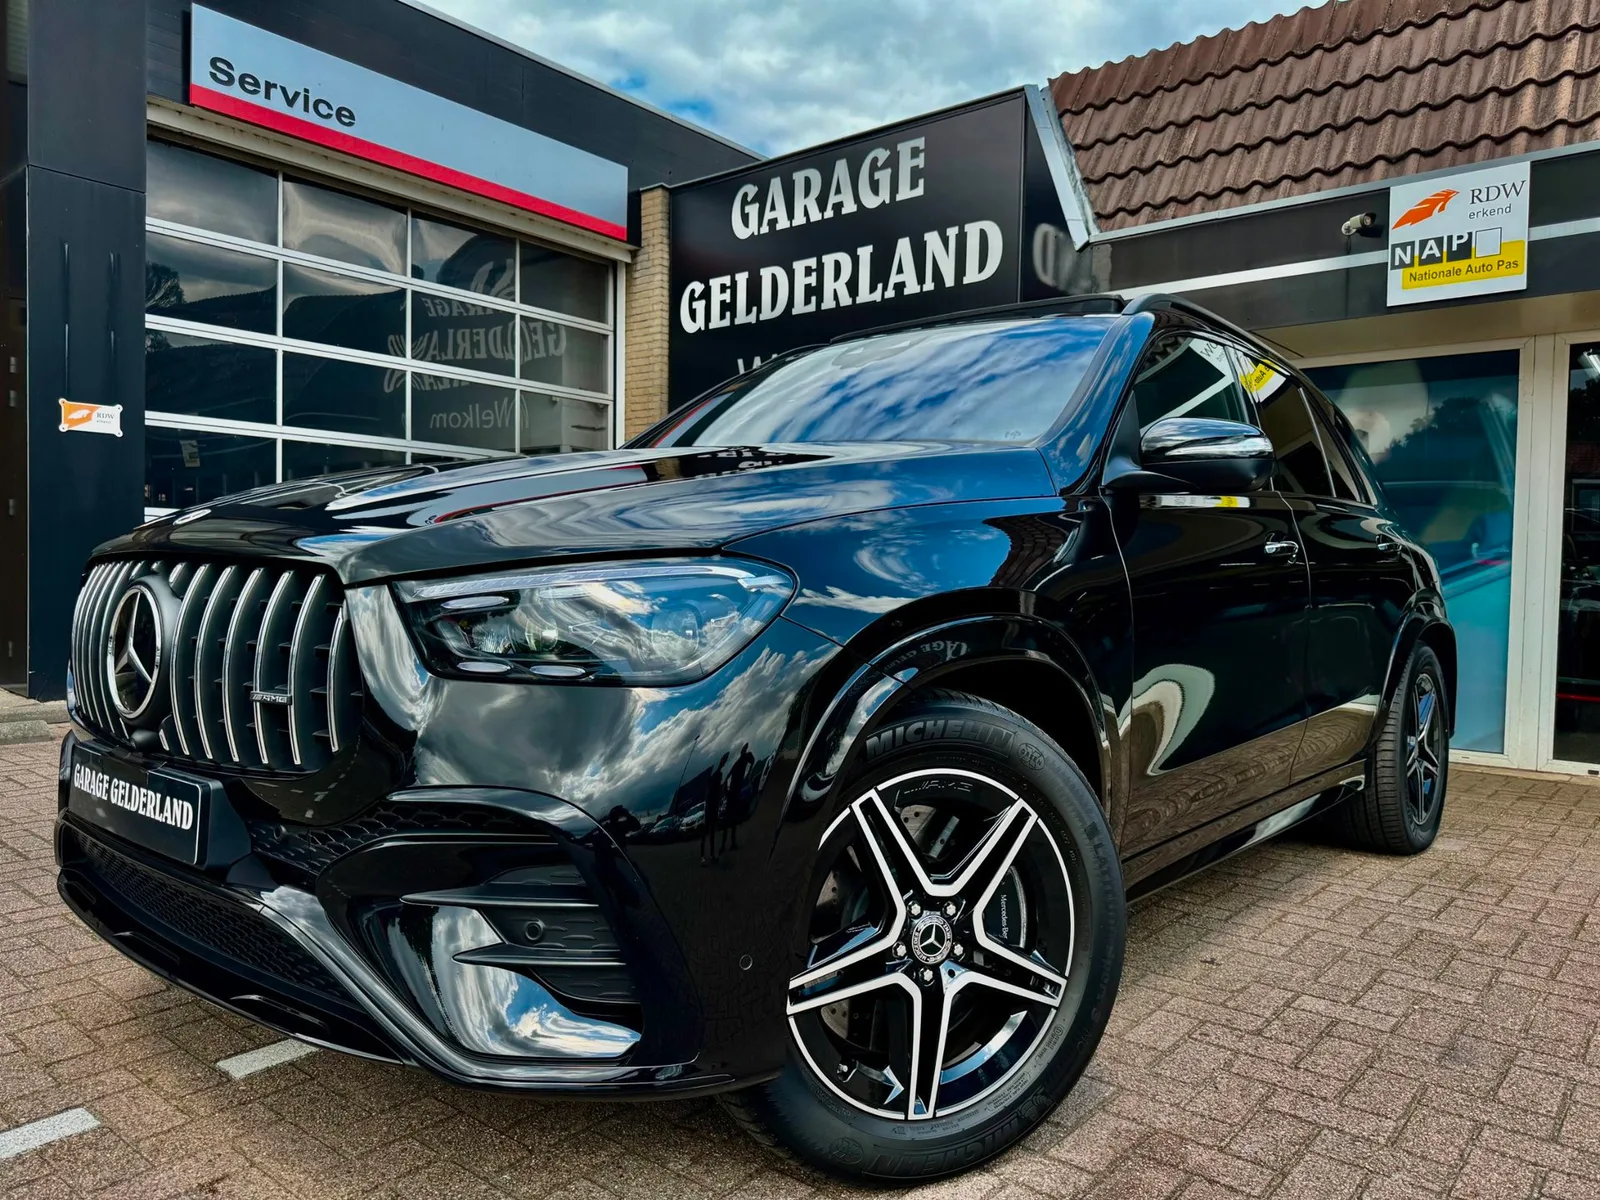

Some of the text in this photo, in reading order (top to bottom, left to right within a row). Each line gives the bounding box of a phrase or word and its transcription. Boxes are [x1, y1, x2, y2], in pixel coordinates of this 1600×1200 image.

[209, 56, 356, 128] Service
[731, 137, 926, 240] GARAGE
[1469, 180, 1527, 205] RDW
[1468, 204, 1512, 220] erkend
[680, 219, 1003, 334] GELDERLAND
[1409, 259, 1519, 283] Nationale Auto Pas
[96, 412, 115, 420] RDW
[865, 719, 1015, 763] MICHELIN
[74, 763, 194, 831] GARAGE GELDERLAND
